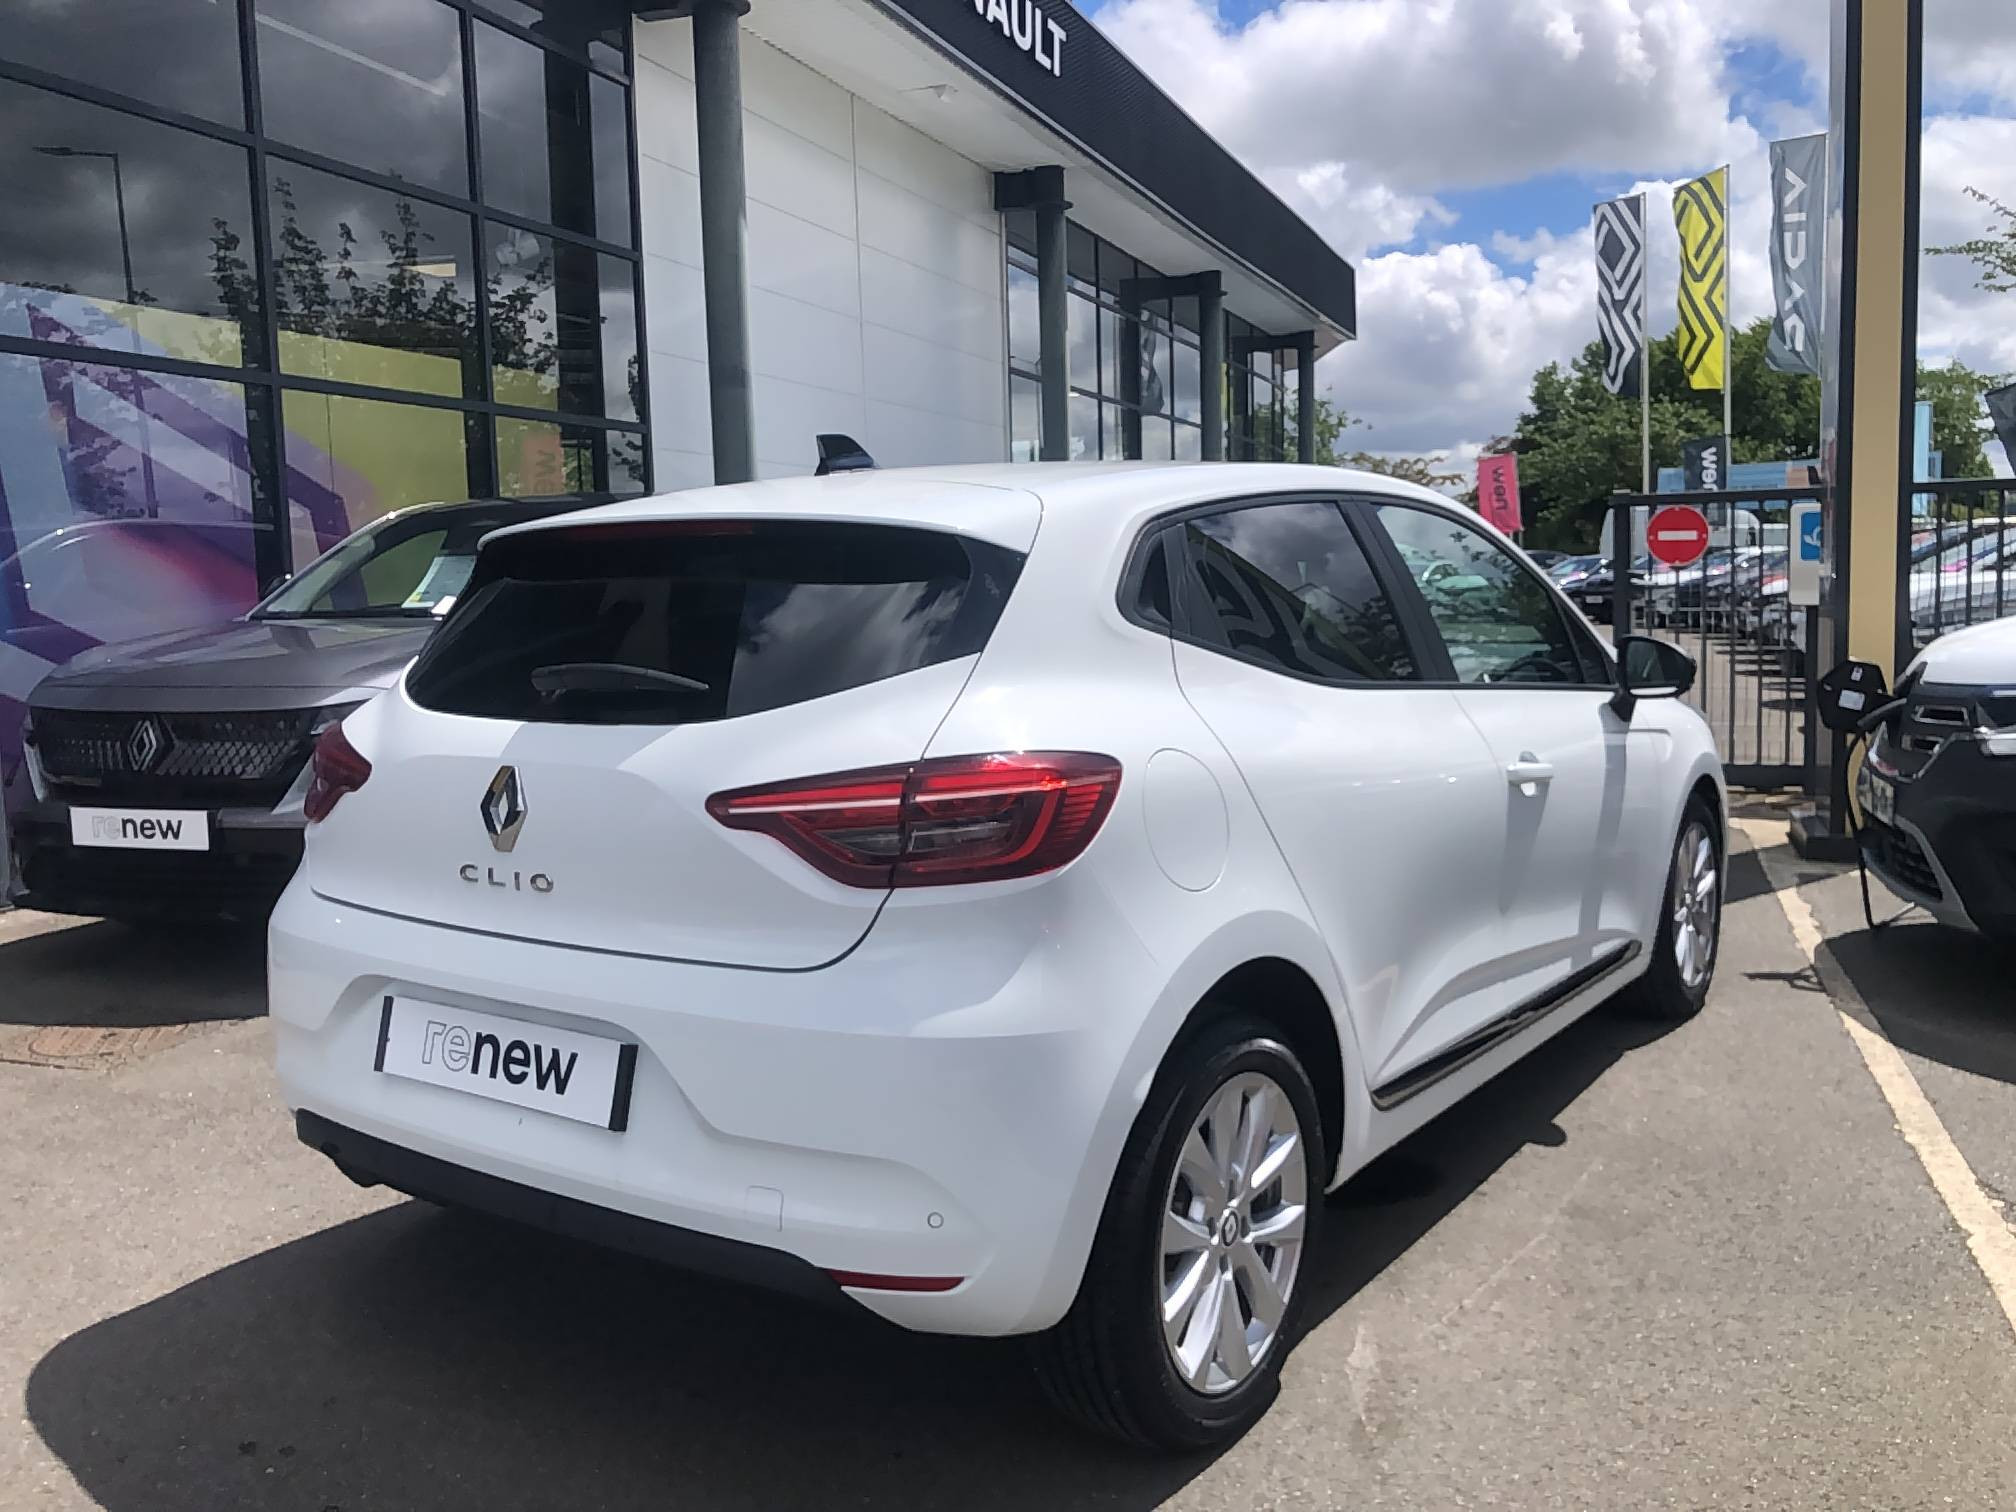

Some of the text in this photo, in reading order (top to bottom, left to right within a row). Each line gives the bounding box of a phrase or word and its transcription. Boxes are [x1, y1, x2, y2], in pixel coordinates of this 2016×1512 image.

[974, 0, 1067, 77] AULT
[91, 815, 182, 840] renew
[459, 863, 554, 893] CLIO
[421, 1019, 579, 1096] renew
